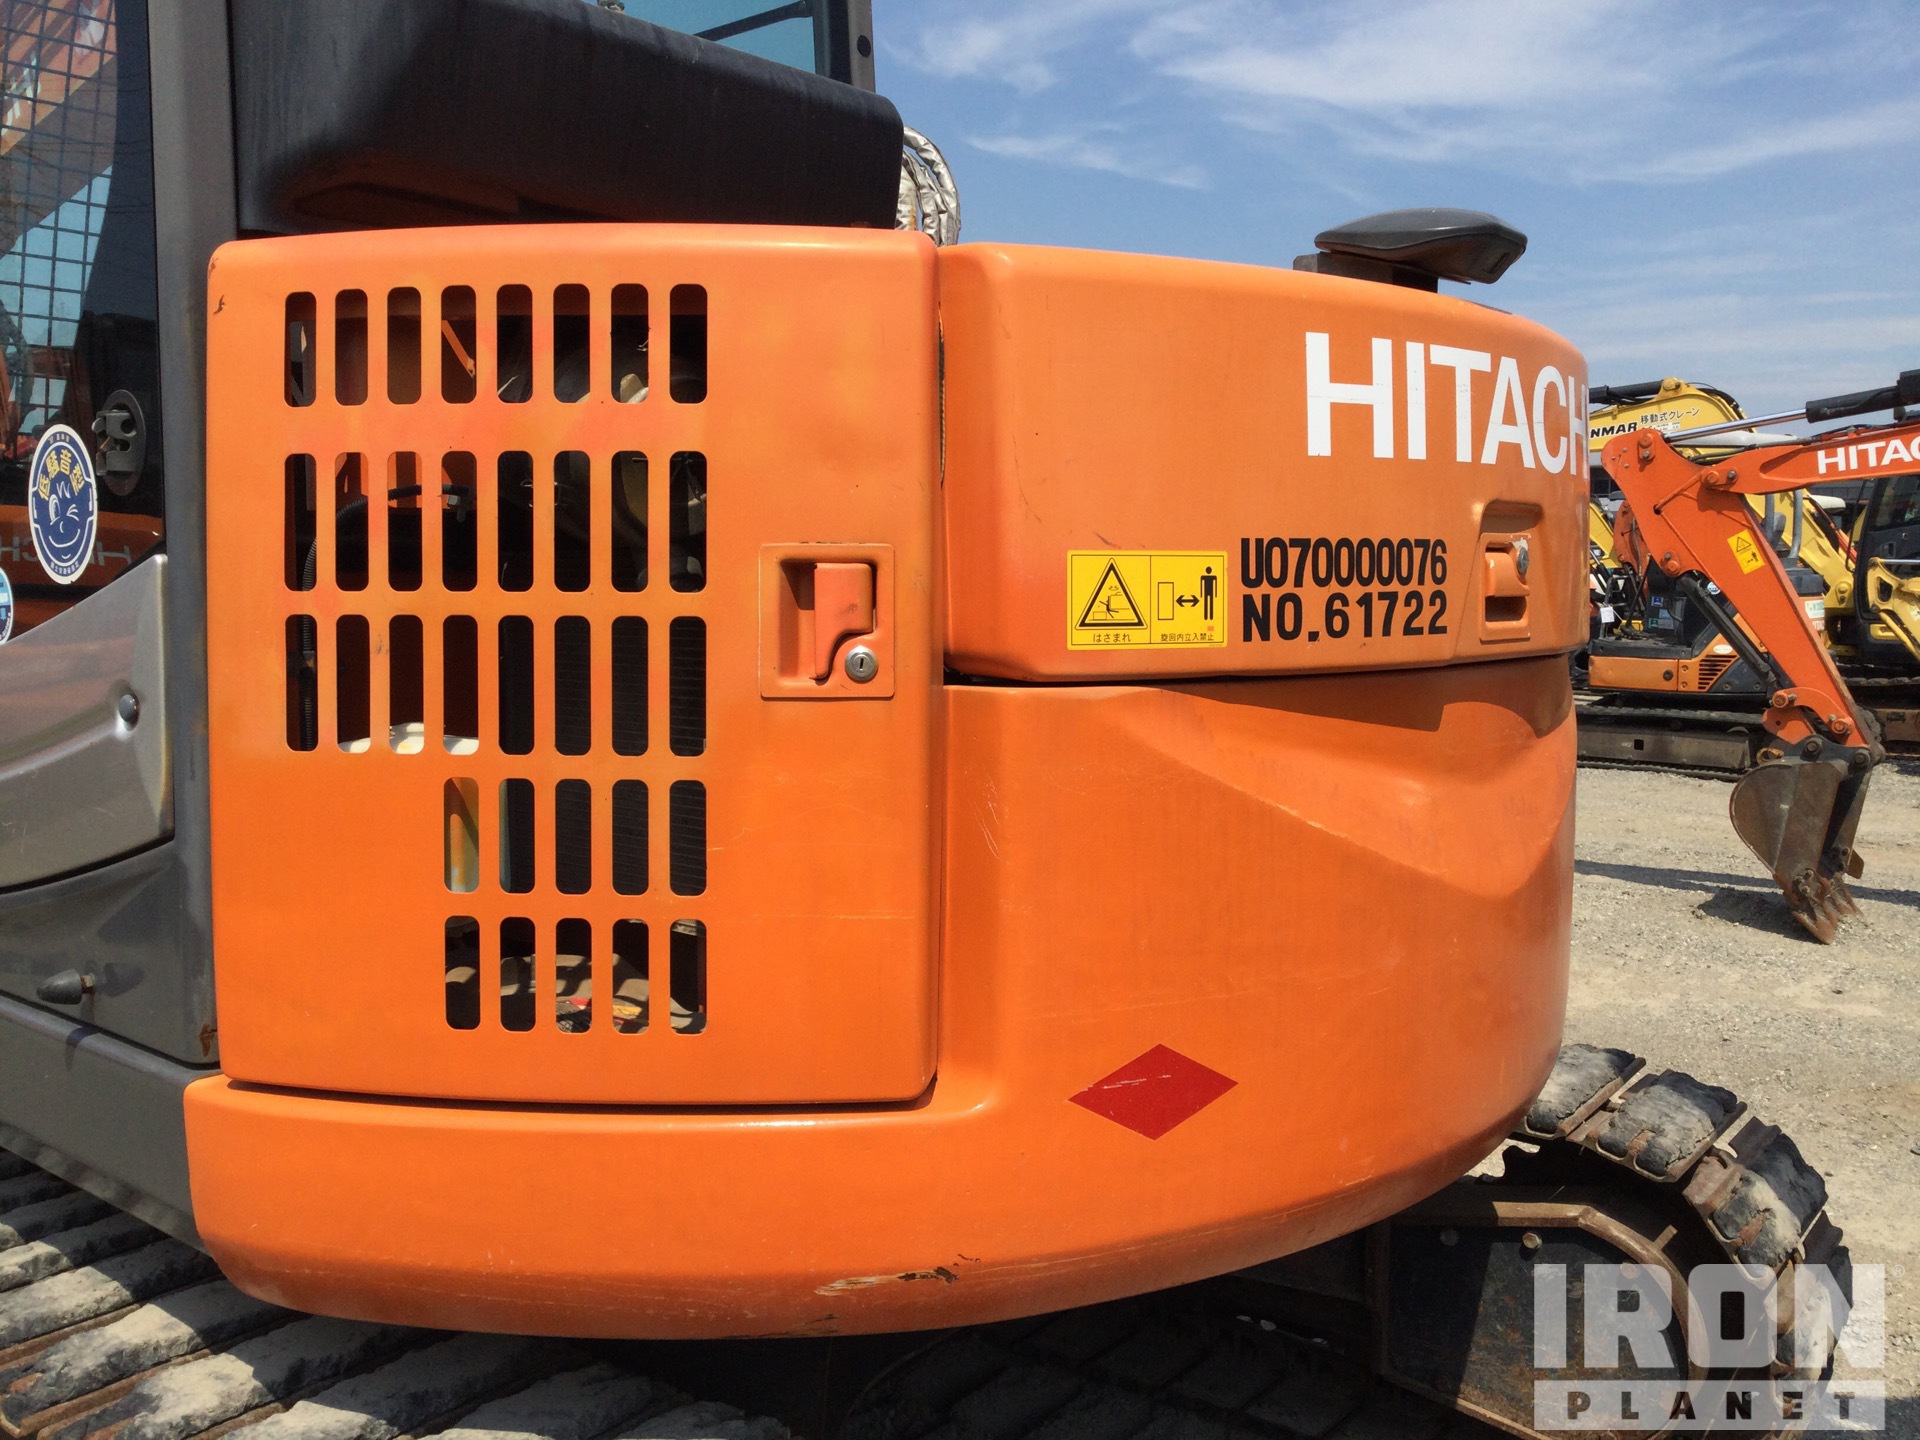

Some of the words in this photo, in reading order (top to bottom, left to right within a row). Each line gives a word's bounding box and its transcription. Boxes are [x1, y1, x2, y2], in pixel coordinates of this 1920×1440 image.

[1640, 408, 1700, 424] 移動式クレーン
[1241, 537, 1447, 589] U070000076
[1243, 590, 1447, 642] NO.61722
[1093, 633, 1131, 643] はさまれ
[1161, 633, 1214, 642] 旋回内立入禁止
